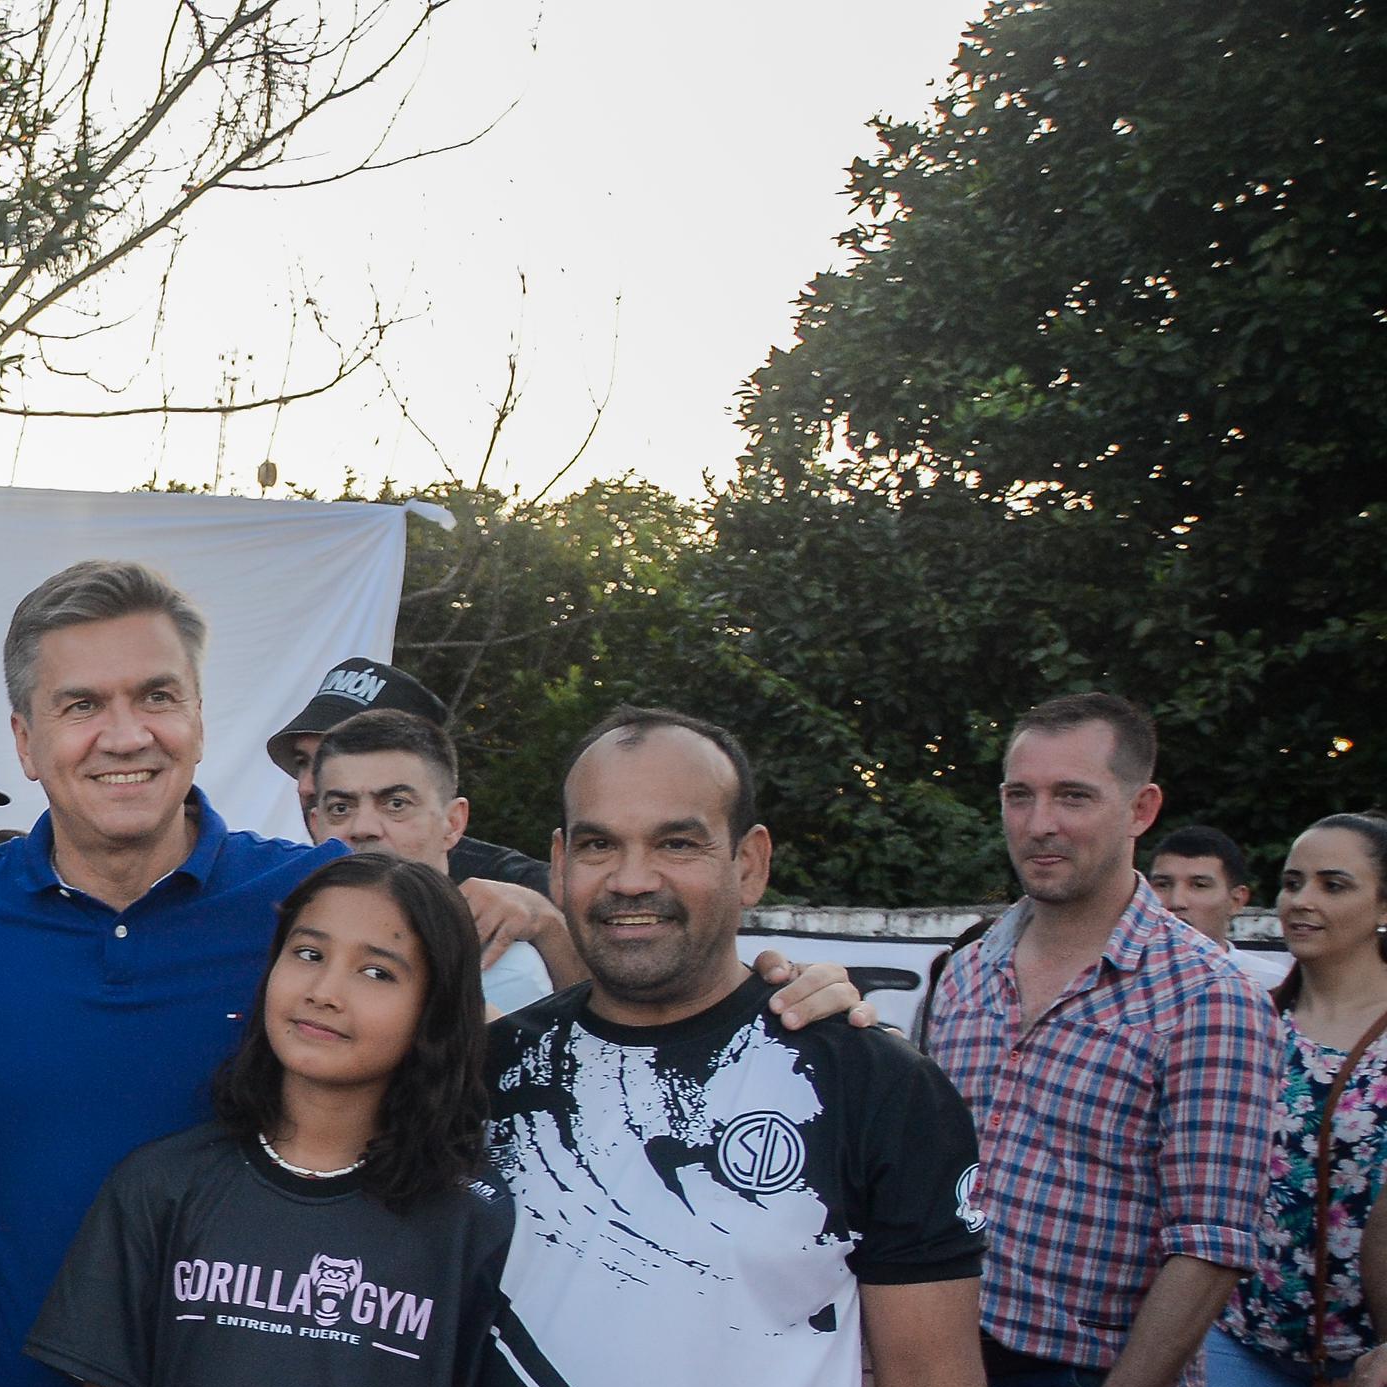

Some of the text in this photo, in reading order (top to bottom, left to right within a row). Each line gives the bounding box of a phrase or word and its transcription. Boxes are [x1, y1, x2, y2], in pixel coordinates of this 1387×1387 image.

[174, 1258, 434, 1341] GORILLA GYM
[216, 1315, 362, 1345] ENTRENA FUERTE
